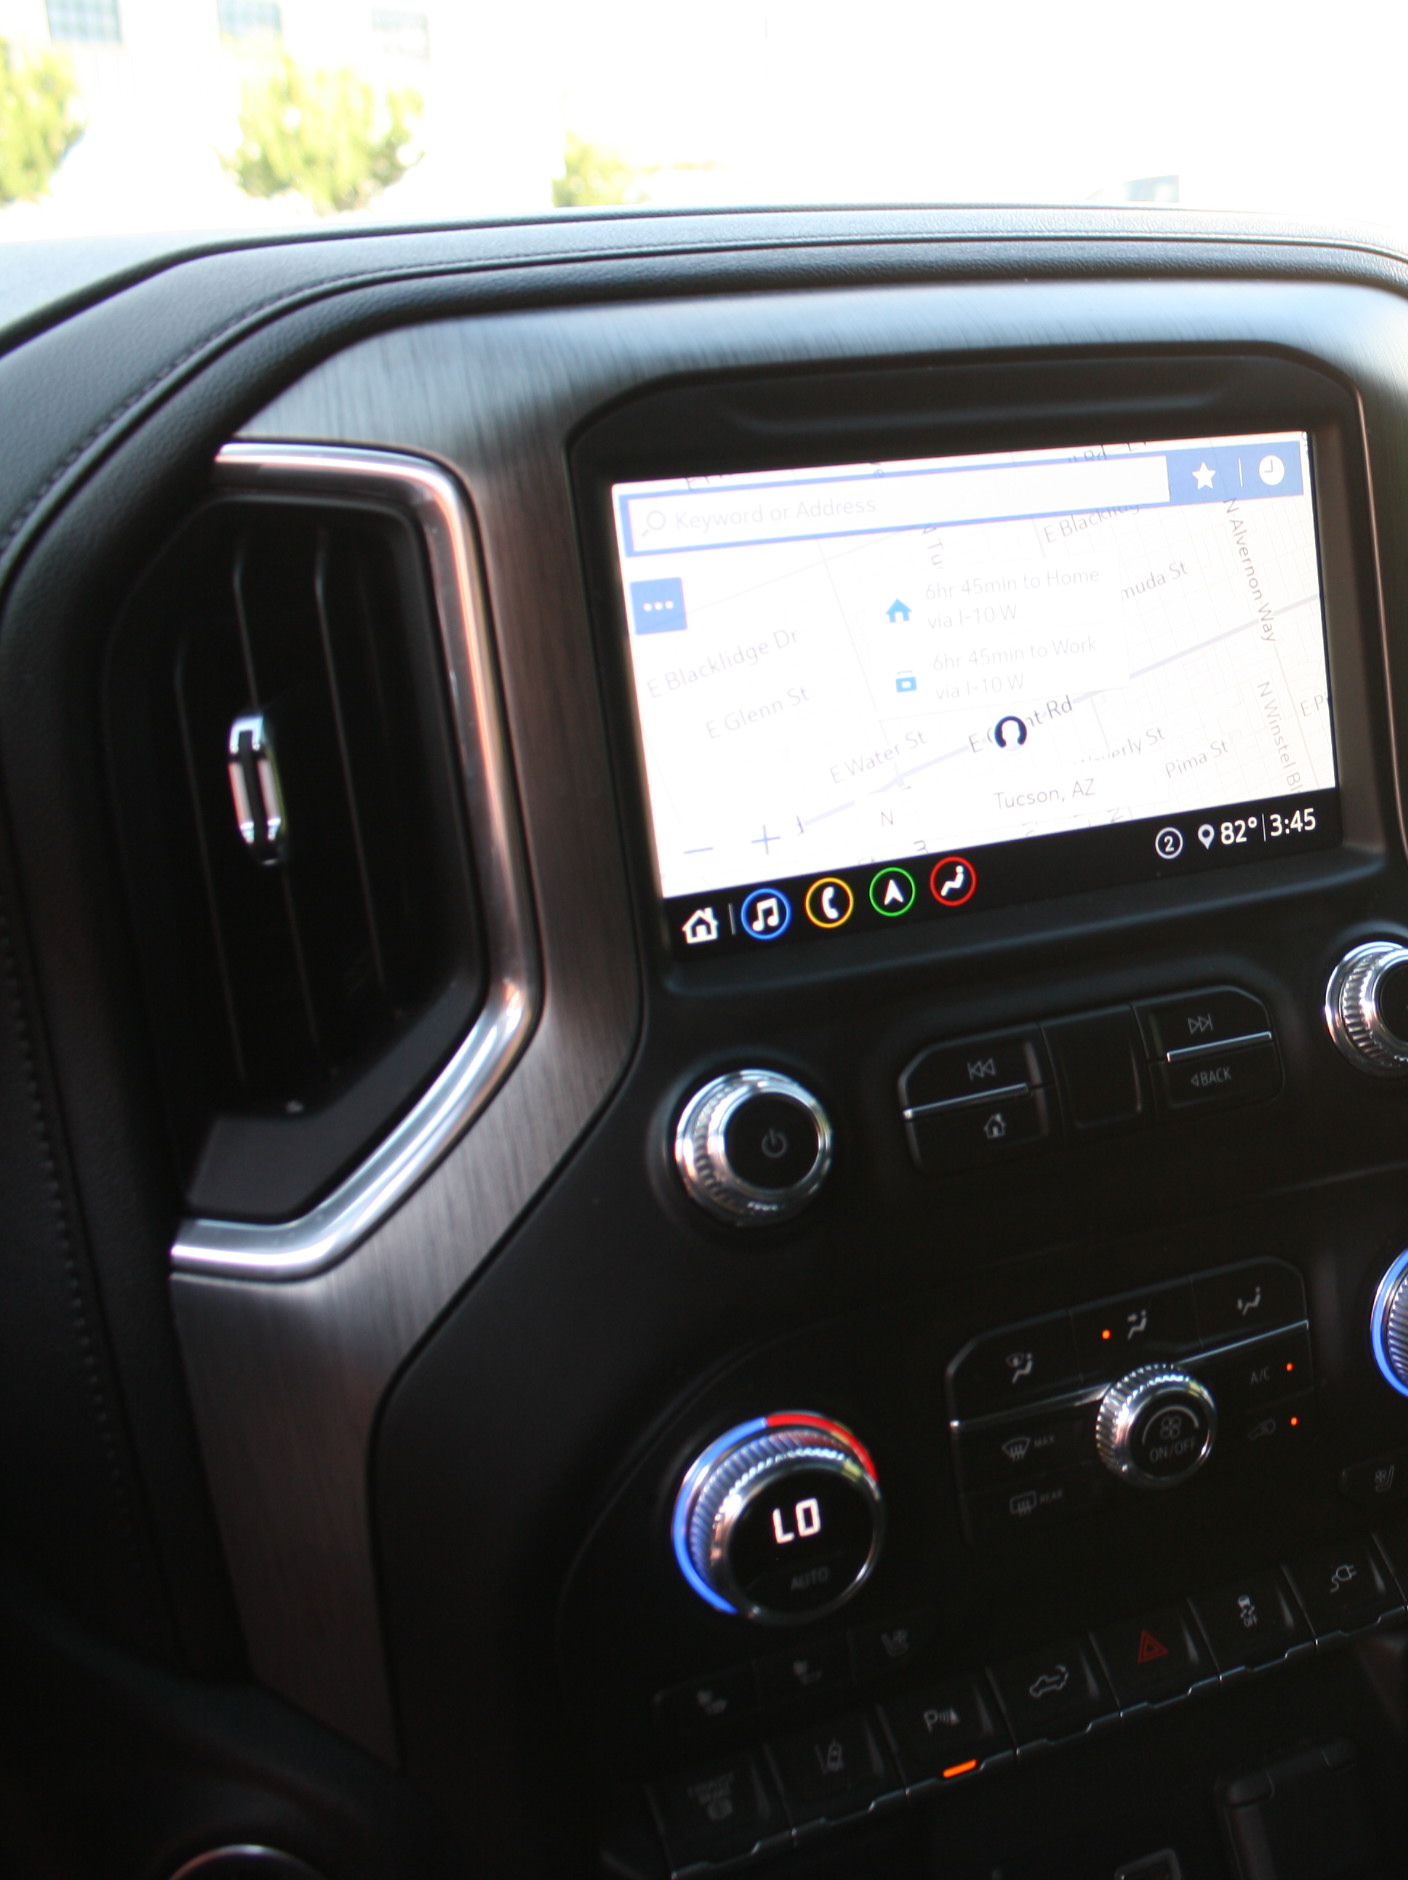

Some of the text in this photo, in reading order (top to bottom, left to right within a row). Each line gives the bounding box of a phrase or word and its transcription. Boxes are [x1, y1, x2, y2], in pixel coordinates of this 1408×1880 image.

[675, 498, 876, 534] Keyword or Address
[1044, 525, 1057, 543] E
[926, 569, 1100, 601] 6hr 45min to Home
[1169, 561, 1189, 580] St
[1229, 519, 1263, 601] Alvernon
[1258, 602, 1277, 643] Way
[927, 603, 1017, 629] via I-10 W
[646, 629, 798, 699] E Blacklidge Dr
[933, 635, 1097, 671] 6hr 45min to Work
[936, 673, 1024, 700] via I-10 W
[1257, 680, 1273, 698] N
[705, 686, 810, 739] E Glenn St
[1300, 692, 1327, 717] E P
[968, 694, 1073, 753] E Rd
[1145, 727, 1166, 746] St
[1264, 698, 1297, 769] Winstel
[829, 730, 928, 784] E Water St
[1165, 739, 1229, 779] Pima St
[993, 778, 1096, 809] Tucson, AZ
[1269, 808, 1316, 837] 3:45
[1200, 1064, 1232, 1087] BACK
[1250, 1366, 1271, 1385] A/C
[1033, 1434, 1056, 1449] MAX
[1149, 1435, 1196, 1463] ON/OFF
[770, 1496, 822, 1545] LO
[790, 1565, 831, 1592] AUTO
